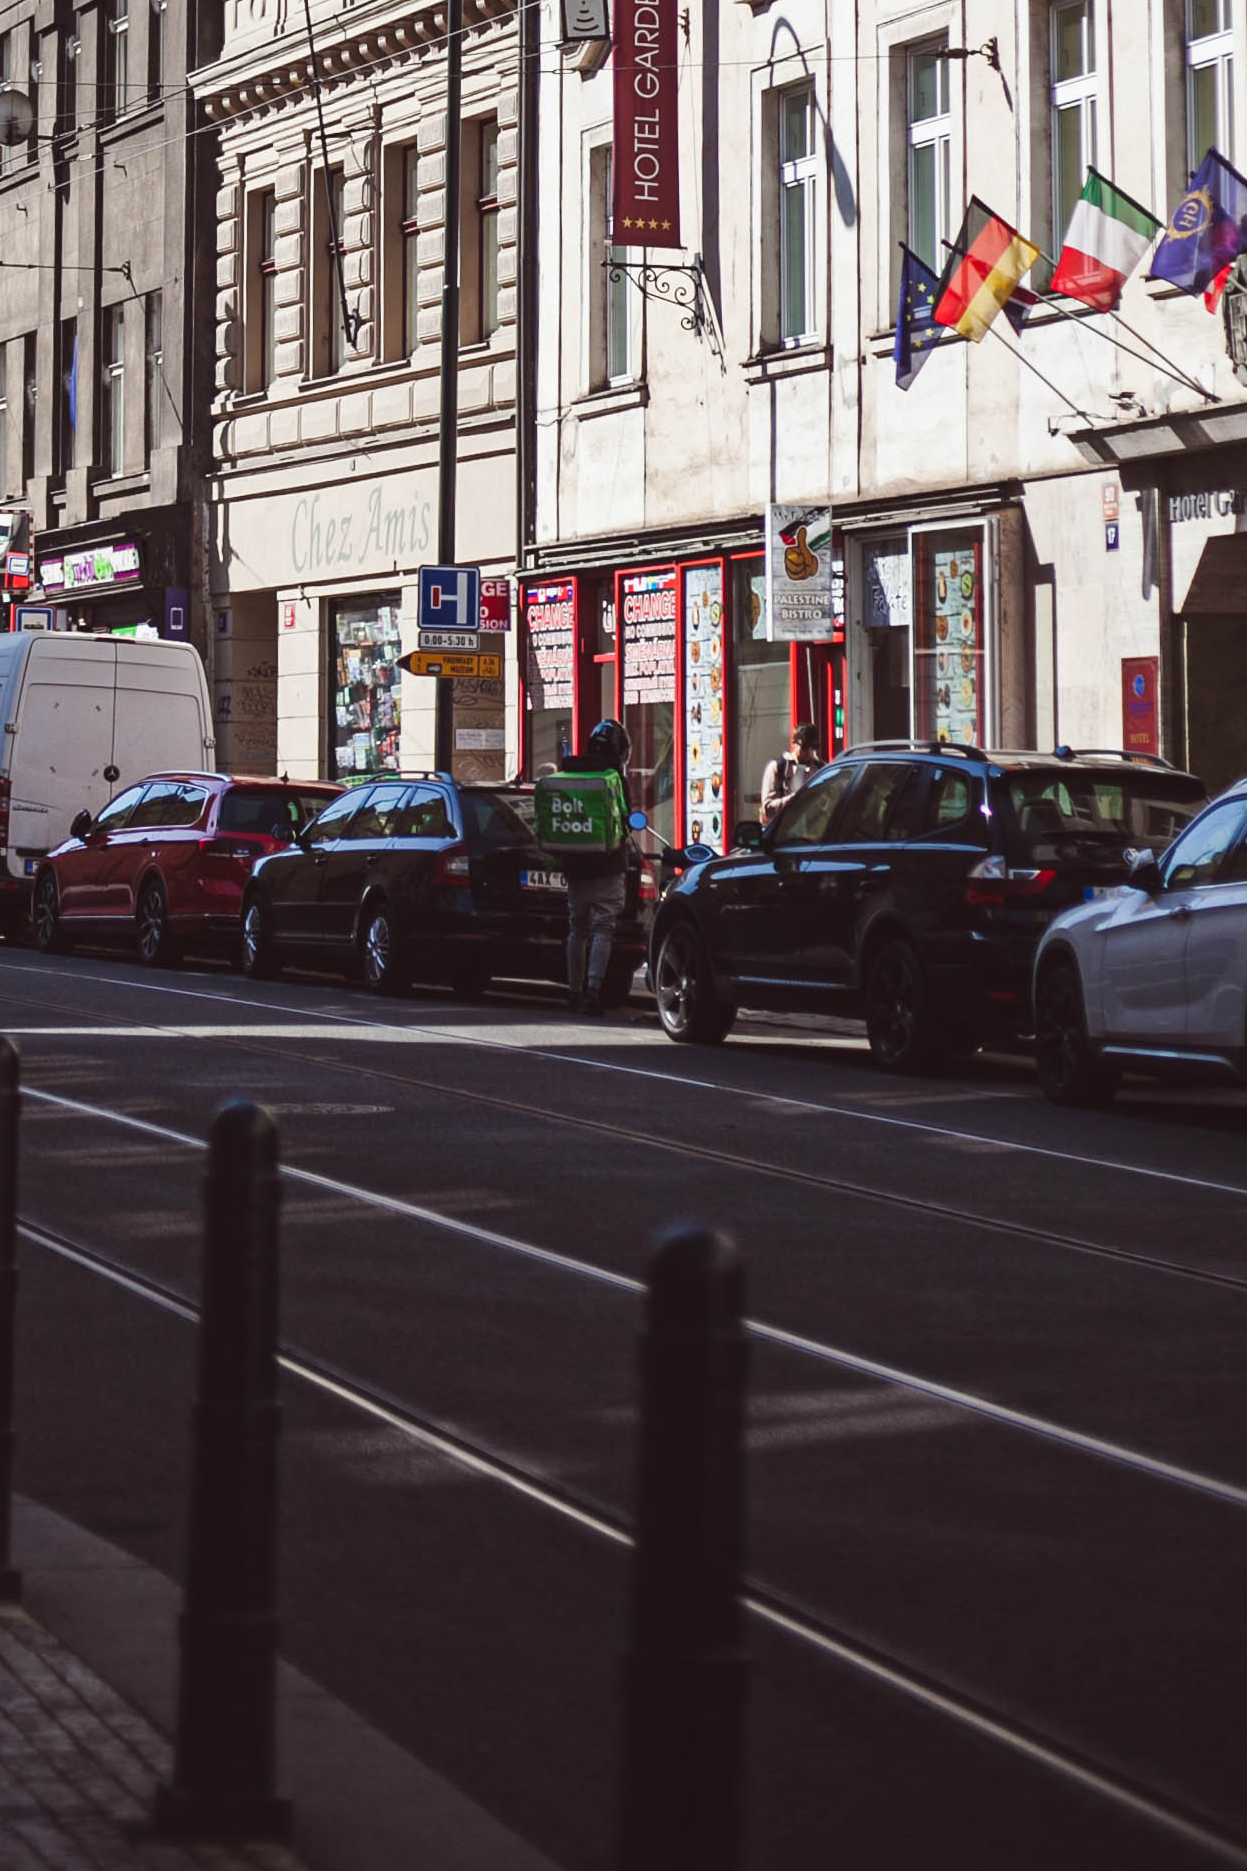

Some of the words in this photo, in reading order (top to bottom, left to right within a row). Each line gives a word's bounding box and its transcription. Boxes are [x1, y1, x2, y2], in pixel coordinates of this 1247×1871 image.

[634, 108, 660, 201] HOTEL
[1169, 491, 1212, 523] Hotel
[292, 492, 353, 572] Chez
[358, 482, 431, 564] Amis
[623, 590, 676, 624] CHANGE
[774, 593, 830, 606] PALESTINE
[781, 609, 823, 619] BISTRO
[527, 601, 573, 633] CHANGE
[551, 797, 584, 814] Bolt
[552, 817, 593, 833] Food
